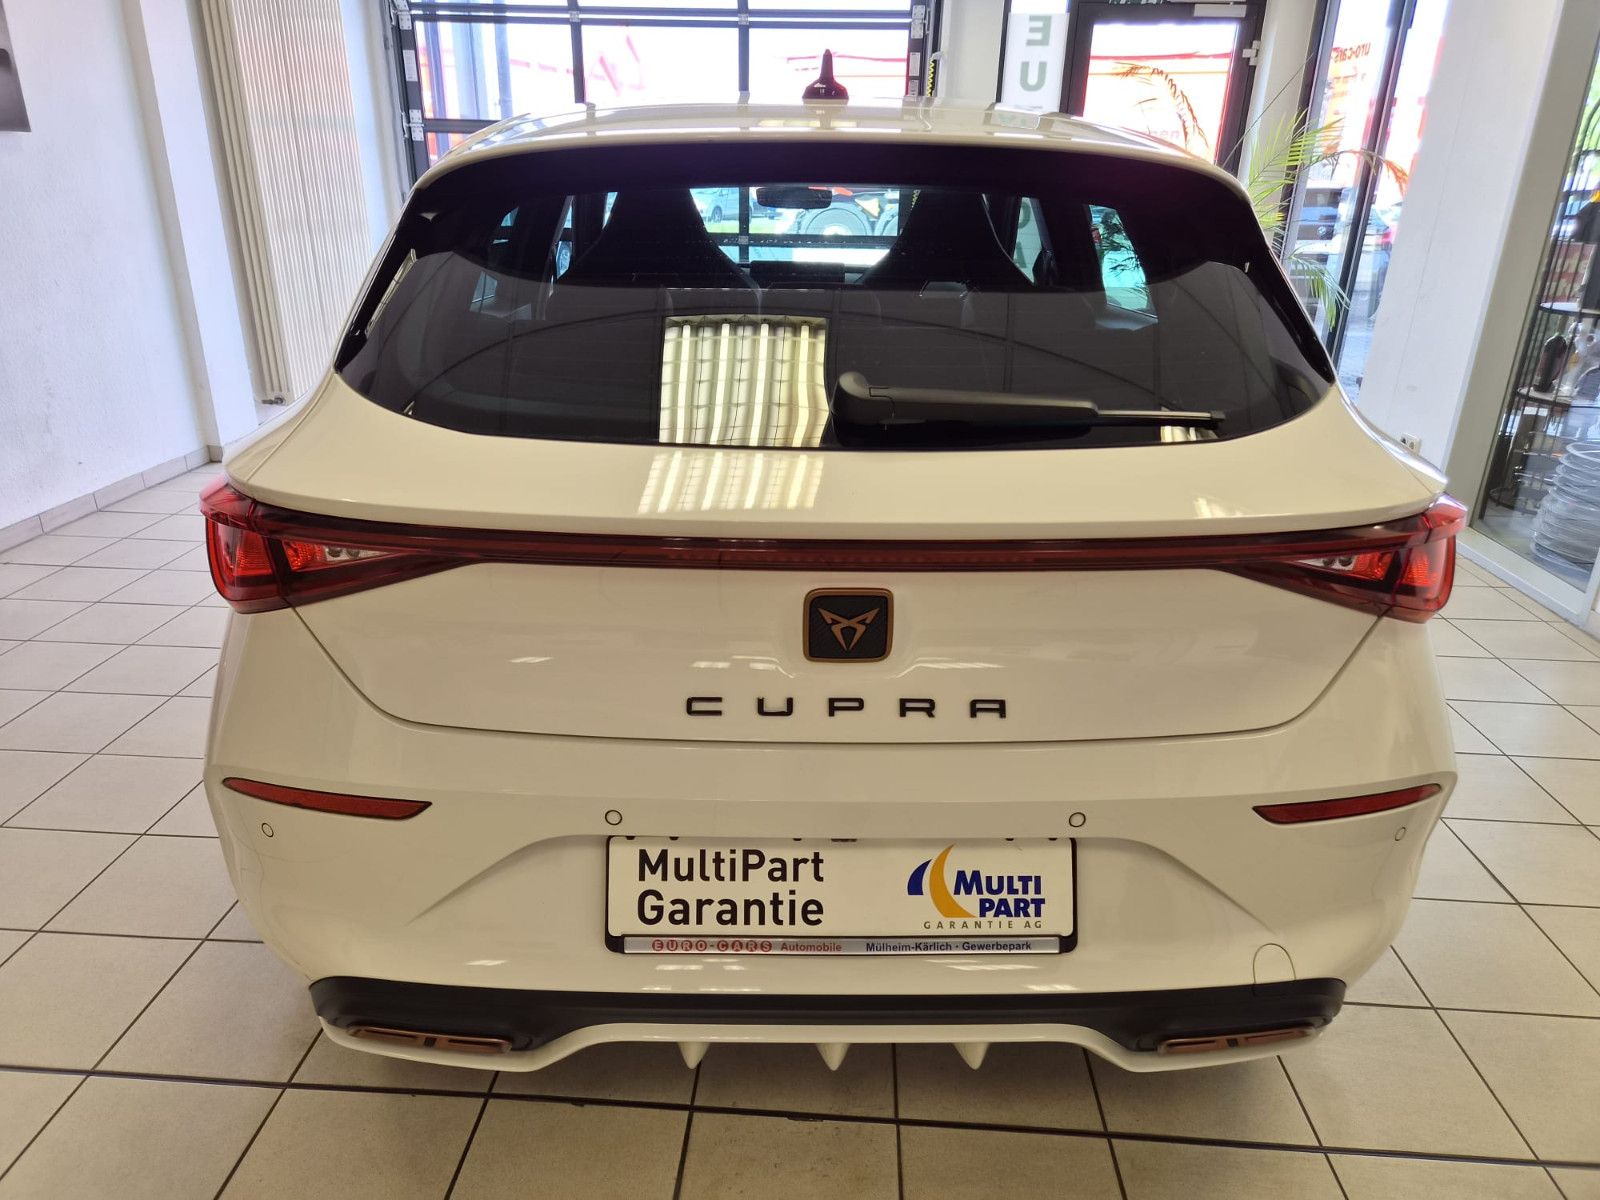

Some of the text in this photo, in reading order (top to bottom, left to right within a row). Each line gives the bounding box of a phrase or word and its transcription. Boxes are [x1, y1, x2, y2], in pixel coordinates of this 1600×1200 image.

[686, 696, 1007, 718] CUPRA
[638, 849, 825, 882] MultiPart
[953, 870, 1042, 895] MULTI
[637, 889, 825, 926] Garantie
[978, 898, 1046, 918] PART
[923, 920, 1042, 930] GARANTIE AG
[651, 939, 843, 952] EURO-CARS Automobile
[866, 941, 1032, 953] Mülheim-Kärlich Gewerbepark
